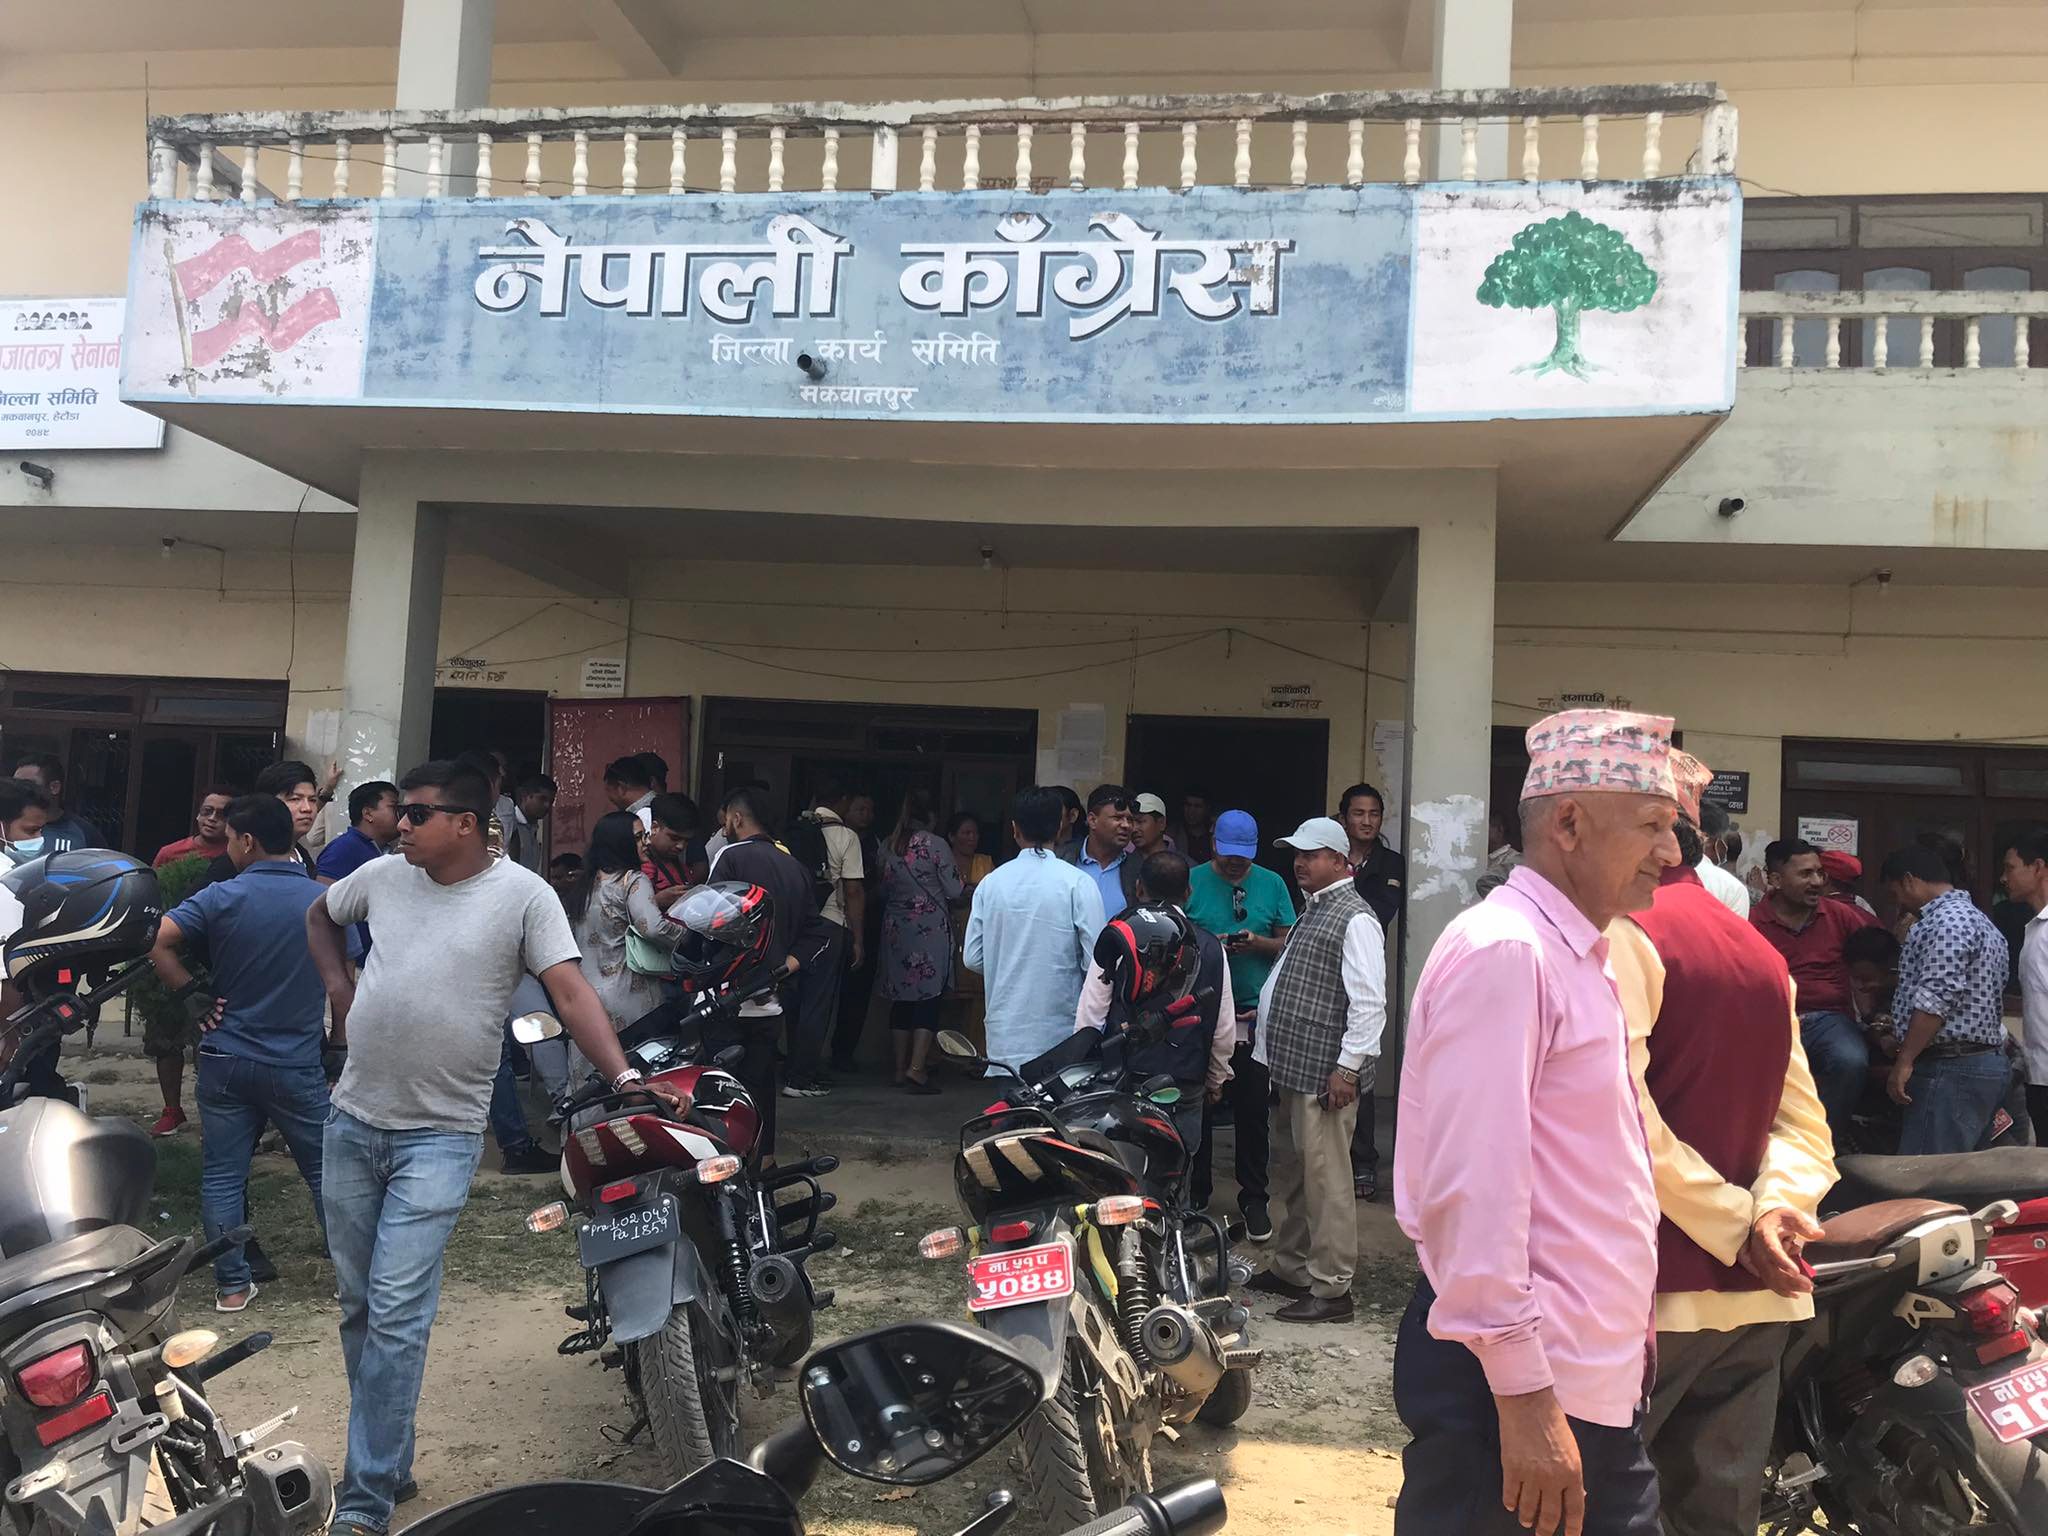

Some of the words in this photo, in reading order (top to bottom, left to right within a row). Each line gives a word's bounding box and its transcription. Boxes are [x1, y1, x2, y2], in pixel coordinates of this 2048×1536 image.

[474, 213, 855, 324] नेपाली
[0, 343, 65, 371] जातन्त्र
[709, 334, 794, 366] जिल्ला
[815, 330, 887, 364] कार्य
[911, 331, 1001, 366] समिति
[47, 387, 100, 406] समिति
[799, 385, 919, 410] मकवानपुर
